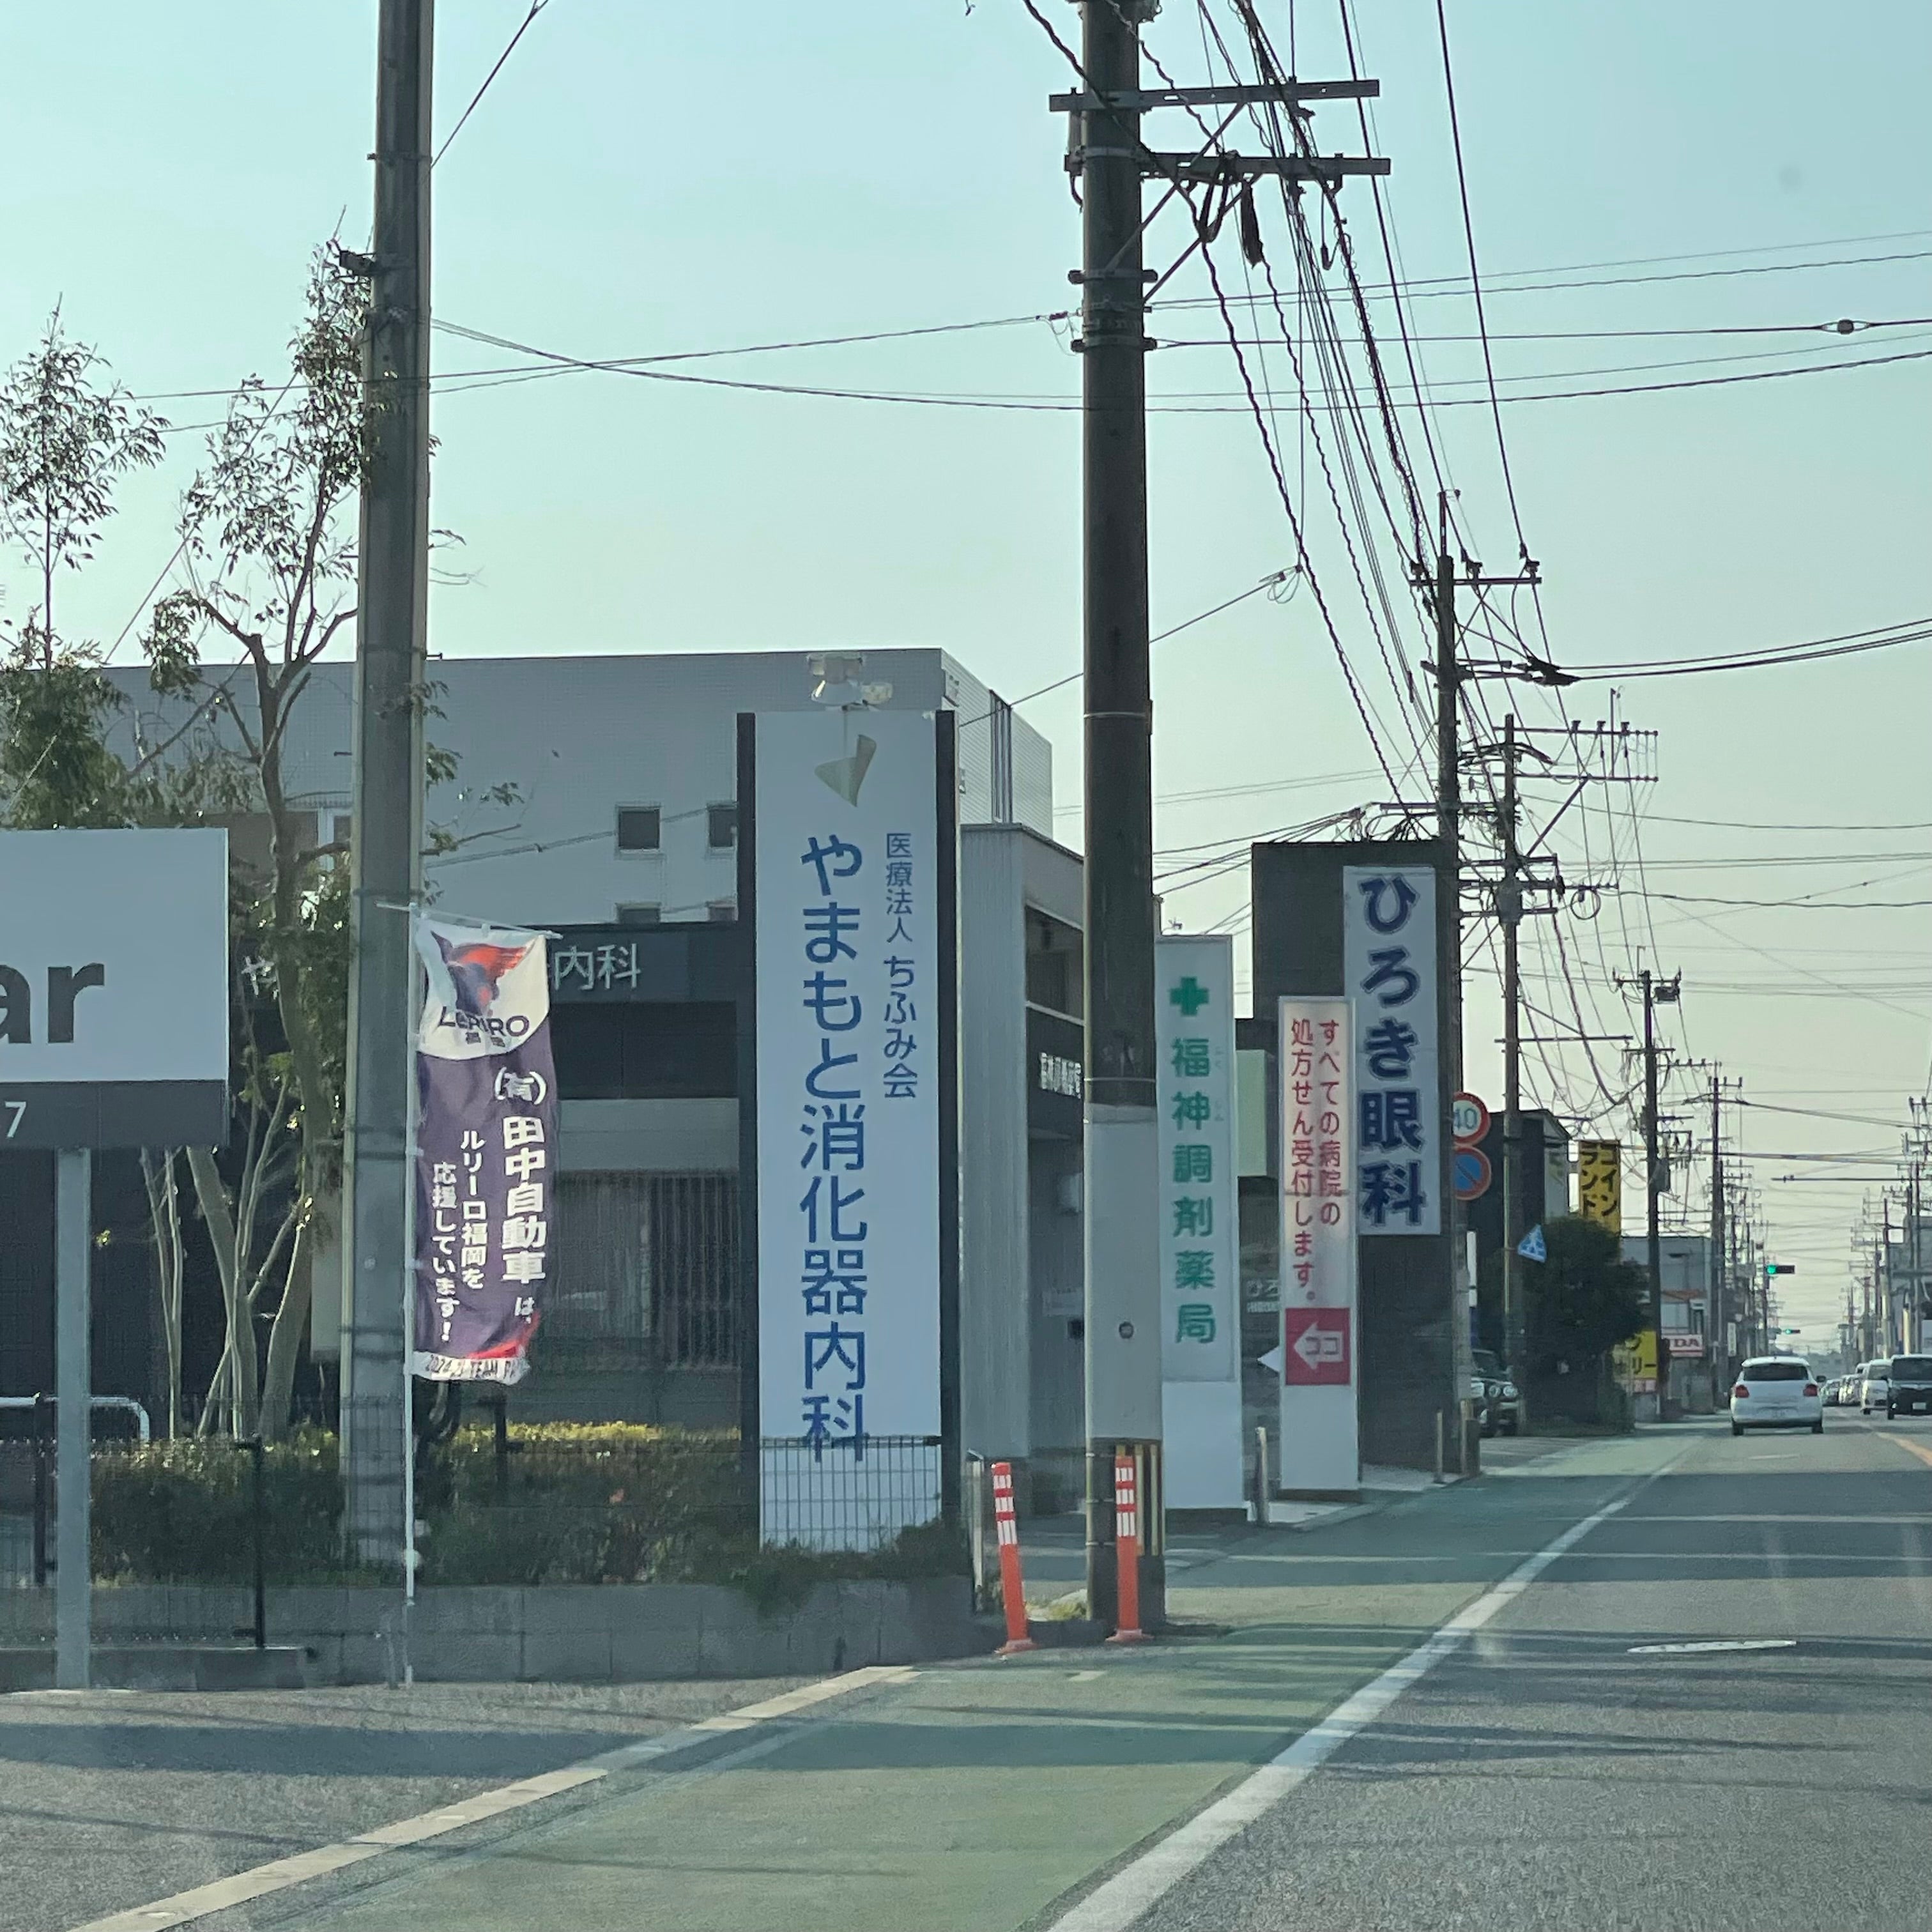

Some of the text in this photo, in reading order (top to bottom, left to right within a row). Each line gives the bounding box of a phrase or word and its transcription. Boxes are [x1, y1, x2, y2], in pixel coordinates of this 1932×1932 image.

[459, 1130, 488, 1289] ルリーロ福岡を
[799, 834, 868, 1462] やまもと消化器内科
[1170, 1037, 1216, 1344] 福神調剤薬局
[1357, 873, 1427, 1227] ひろき眼科
